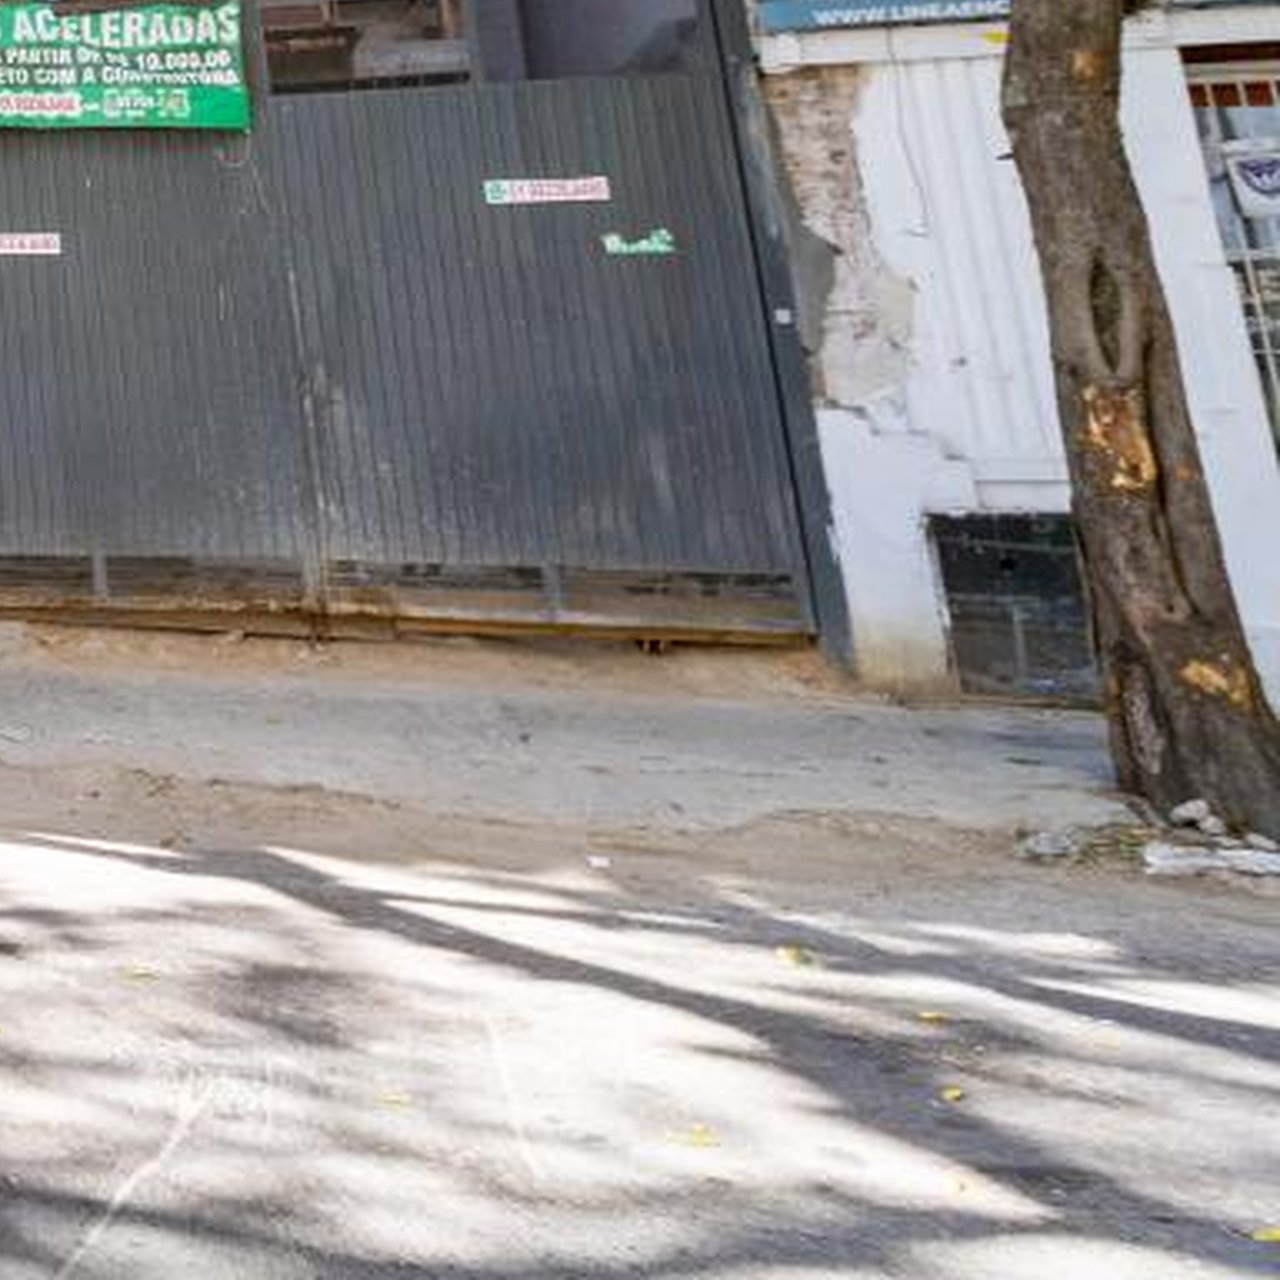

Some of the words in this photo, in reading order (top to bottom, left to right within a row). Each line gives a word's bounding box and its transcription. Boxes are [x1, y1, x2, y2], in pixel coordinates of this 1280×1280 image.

[13, 4, 240, 48] ACELERADAS
[5, 48, 72, 65] PARTIR
[35, 68, 77, 85] COM
[83, 67, 96, 84] A
